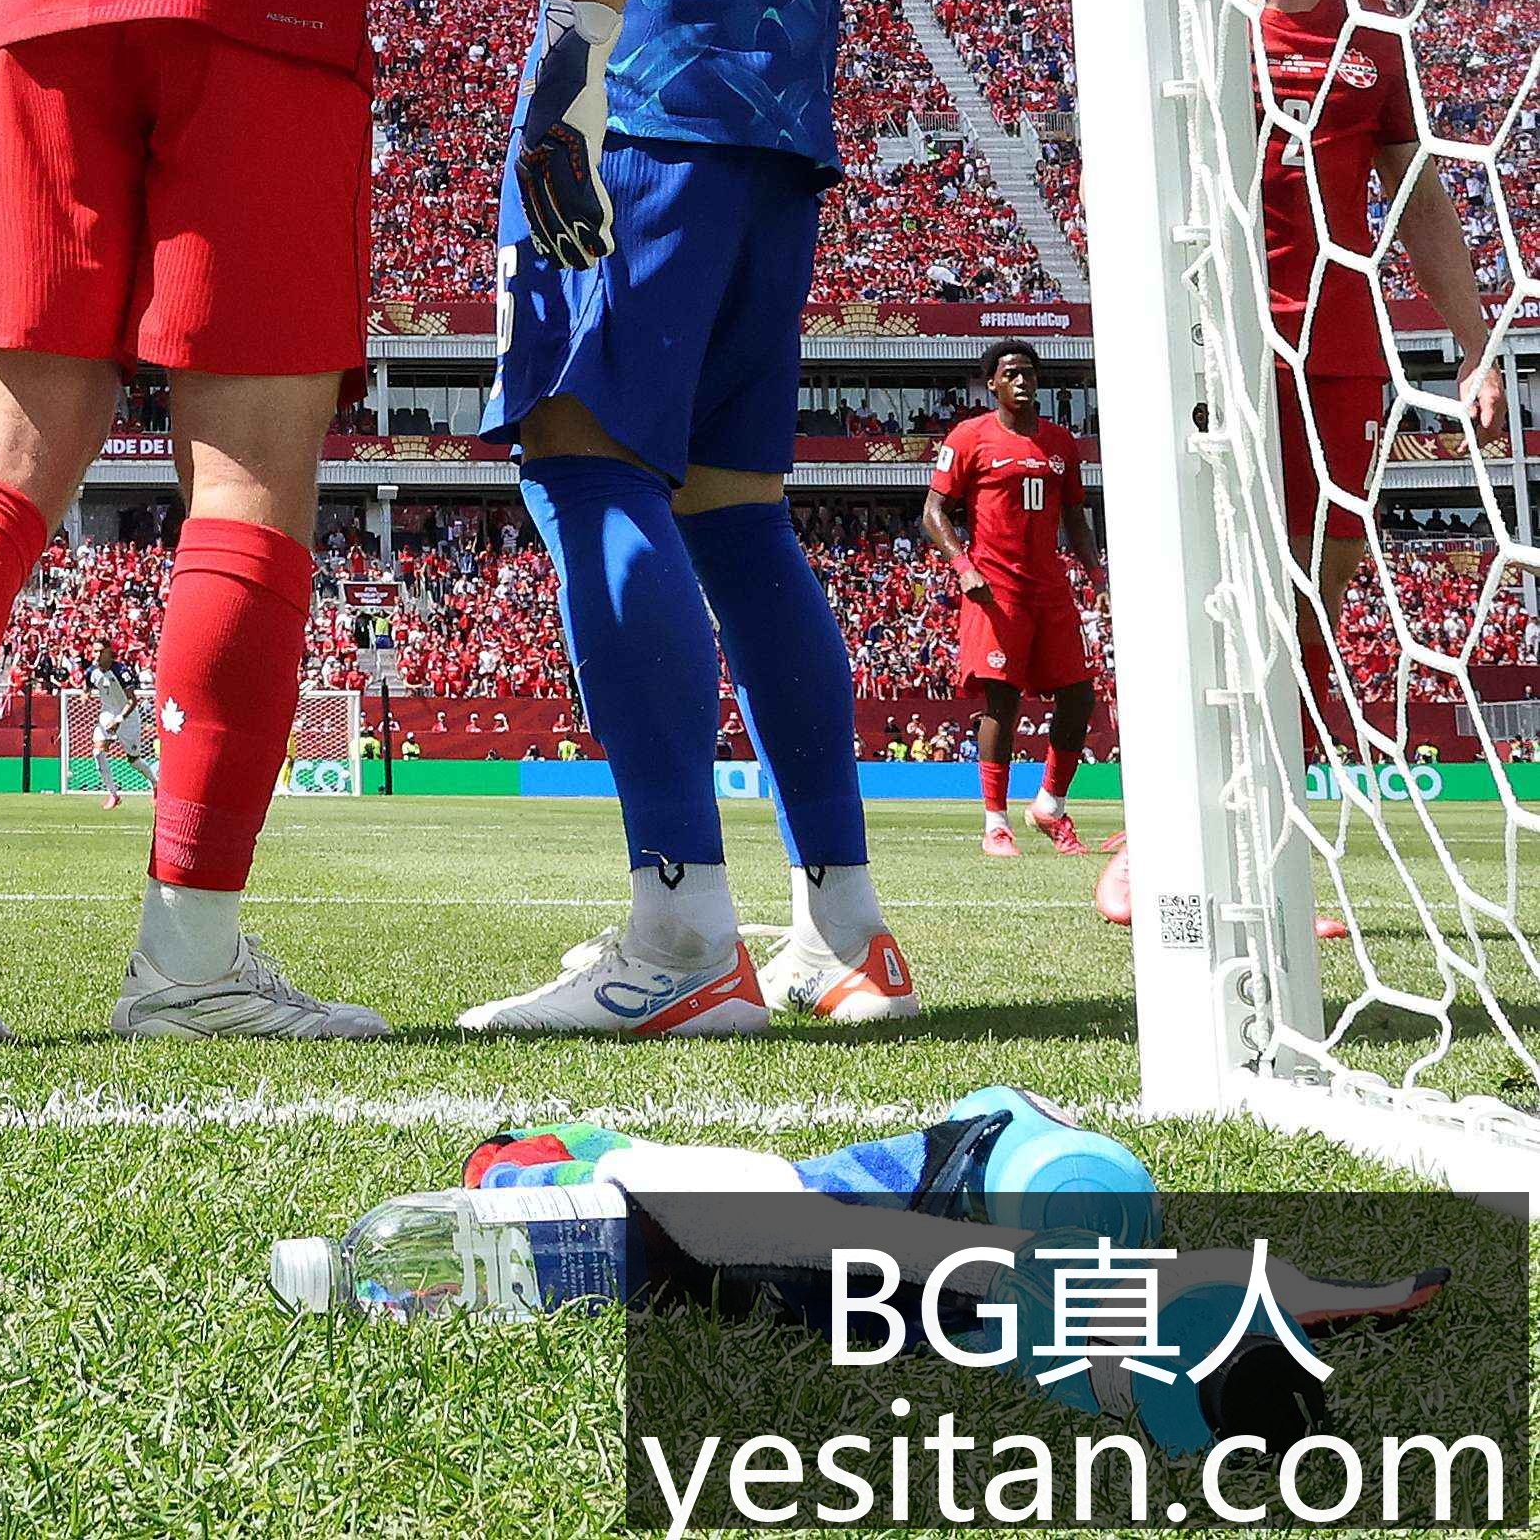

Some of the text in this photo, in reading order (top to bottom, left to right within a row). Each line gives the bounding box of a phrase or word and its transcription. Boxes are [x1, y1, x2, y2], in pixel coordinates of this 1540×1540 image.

[980, 312, 1070, 330] #FIFAWorldCup
[101, 438, 137, 455] NDE
[140, 438, 165, 455] DE
[1022, 476, 1044, 511] 10
[1306, 764, 1443, 801] amco
